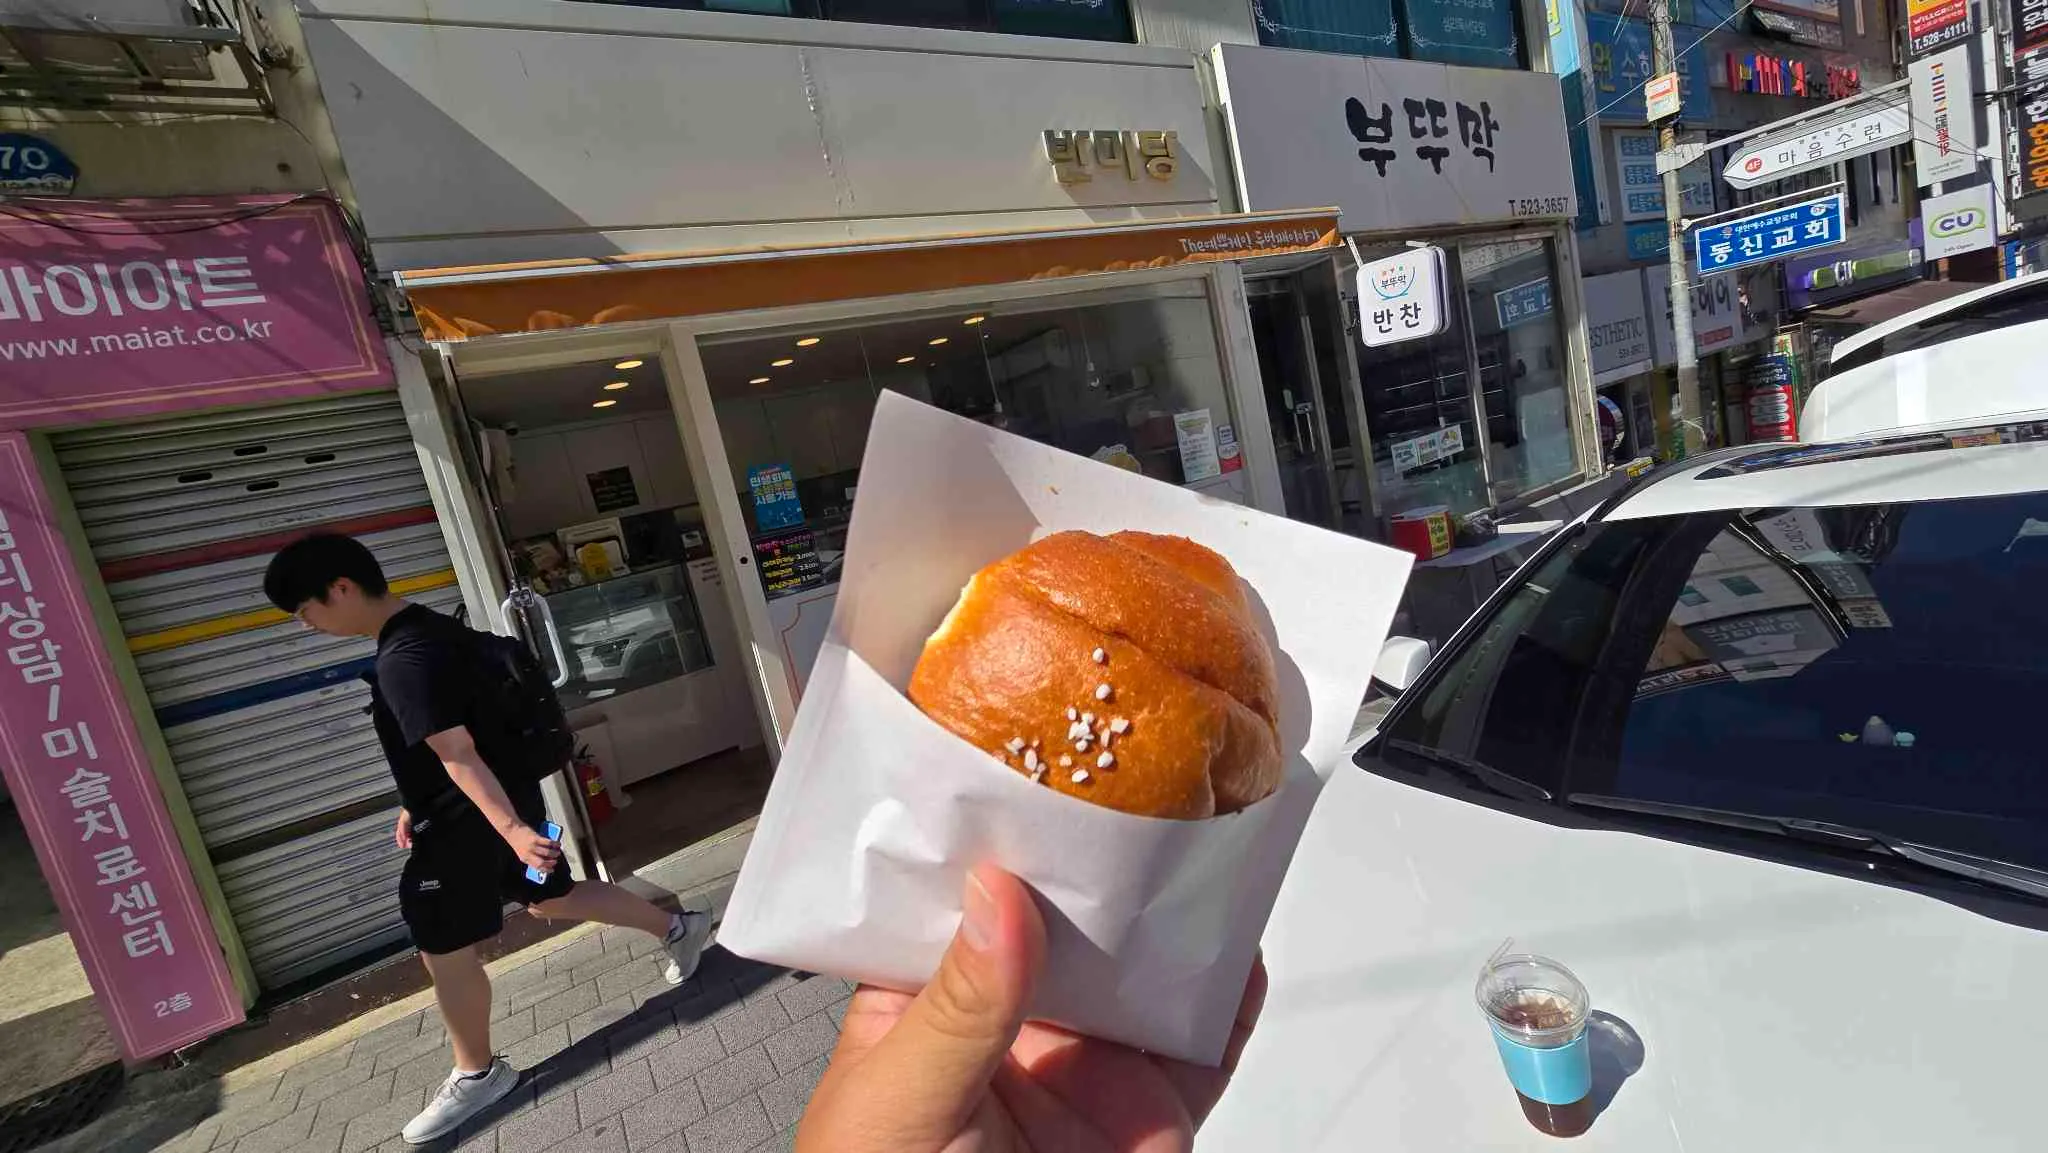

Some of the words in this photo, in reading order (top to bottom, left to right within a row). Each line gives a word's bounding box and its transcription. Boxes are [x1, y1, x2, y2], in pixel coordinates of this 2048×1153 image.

[1914, 21, 1966, 50] T.528-6111
[1344, 97, 1500, 177] 부뚜막
[1778, 121, 1881, 164] 마음수련
[1508, 198, 1570, 216] T.523-3657
[1940, 212, 1974, 232] CU
[1709, 217, 1830, 264] 동신교회
[1381, 274, 1407, 289] 부뚜막
[154, 991, 192, 1018] 2층
